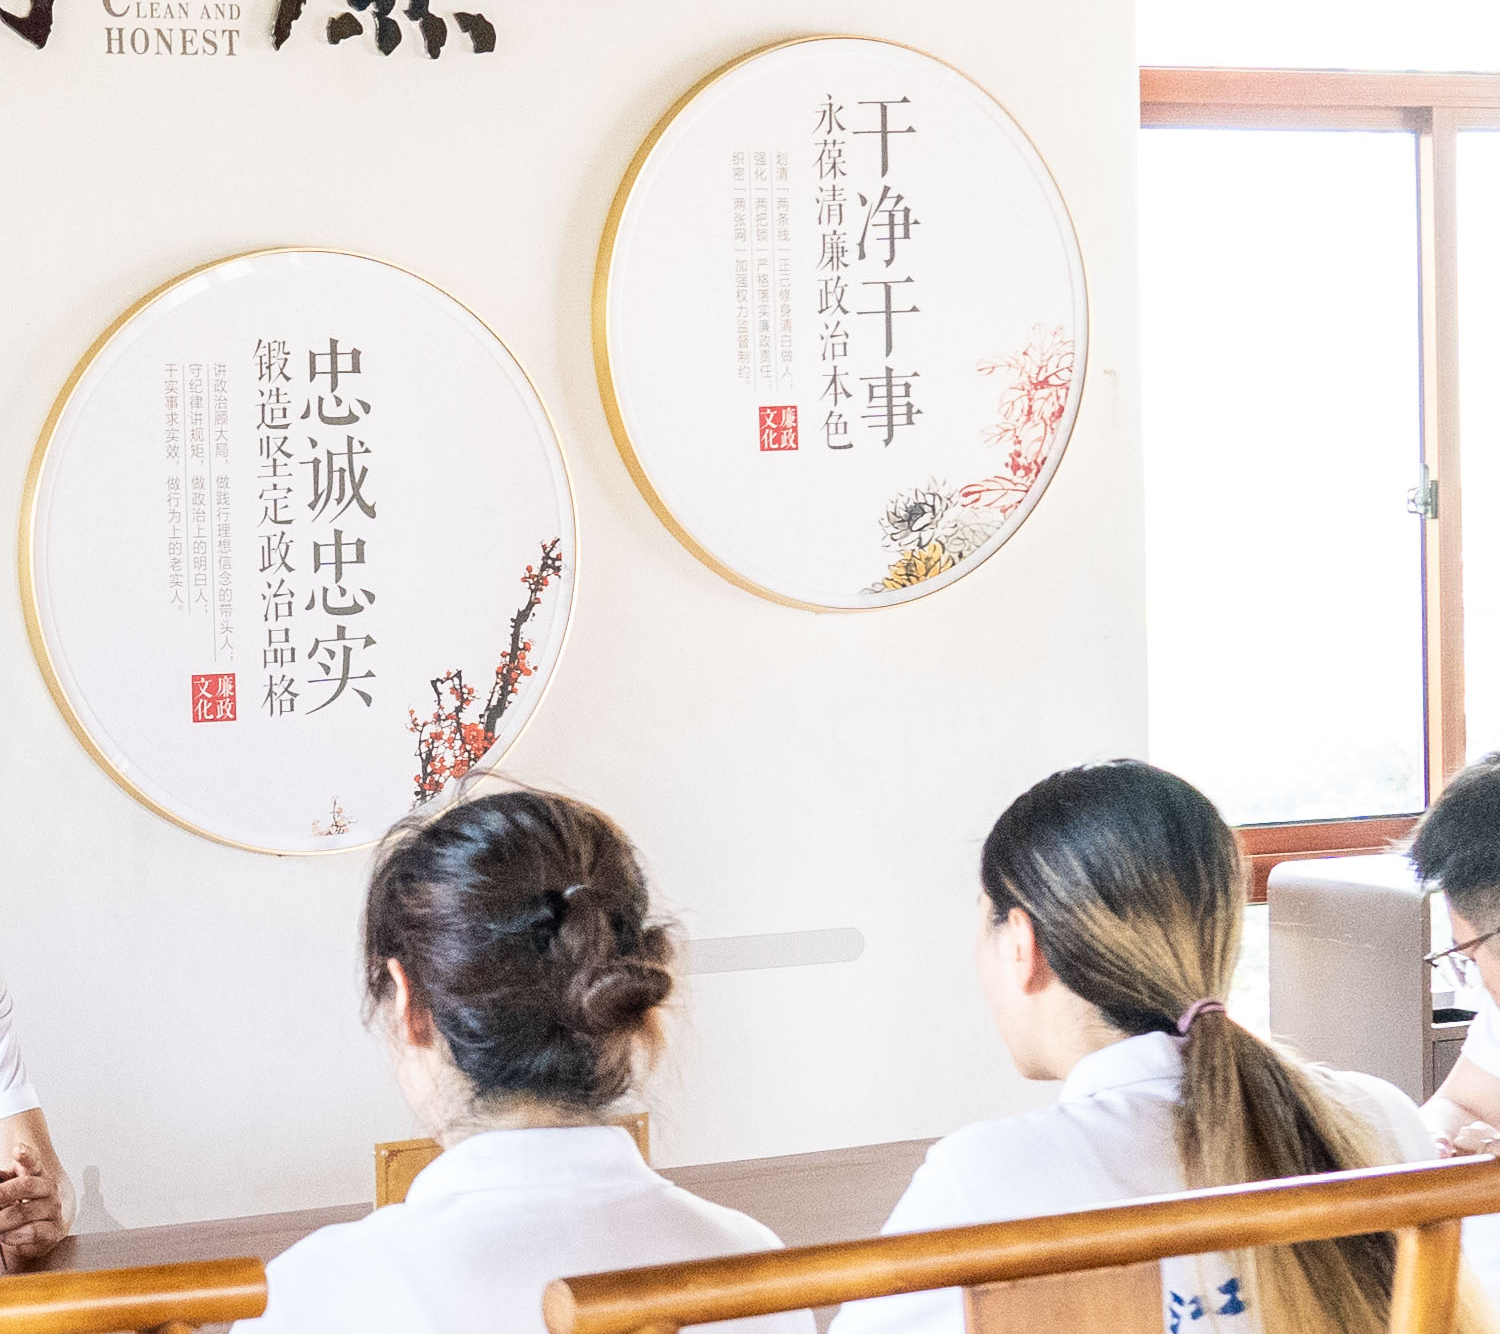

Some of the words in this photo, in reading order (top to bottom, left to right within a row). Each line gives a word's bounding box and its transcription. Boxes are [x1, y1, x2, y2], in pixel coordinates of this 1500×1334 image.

[104, 26, 241, 57] HONEST
[200, 3, 242, 20] AND
[811, 93, 855, 450] 永葆清廉政治本色
[852, 94, 924, 449] 干净干事
[251, 337, 301, 719] 锻造坚定政治品格
[298, 337, 378, 716] 忠诚忠实
